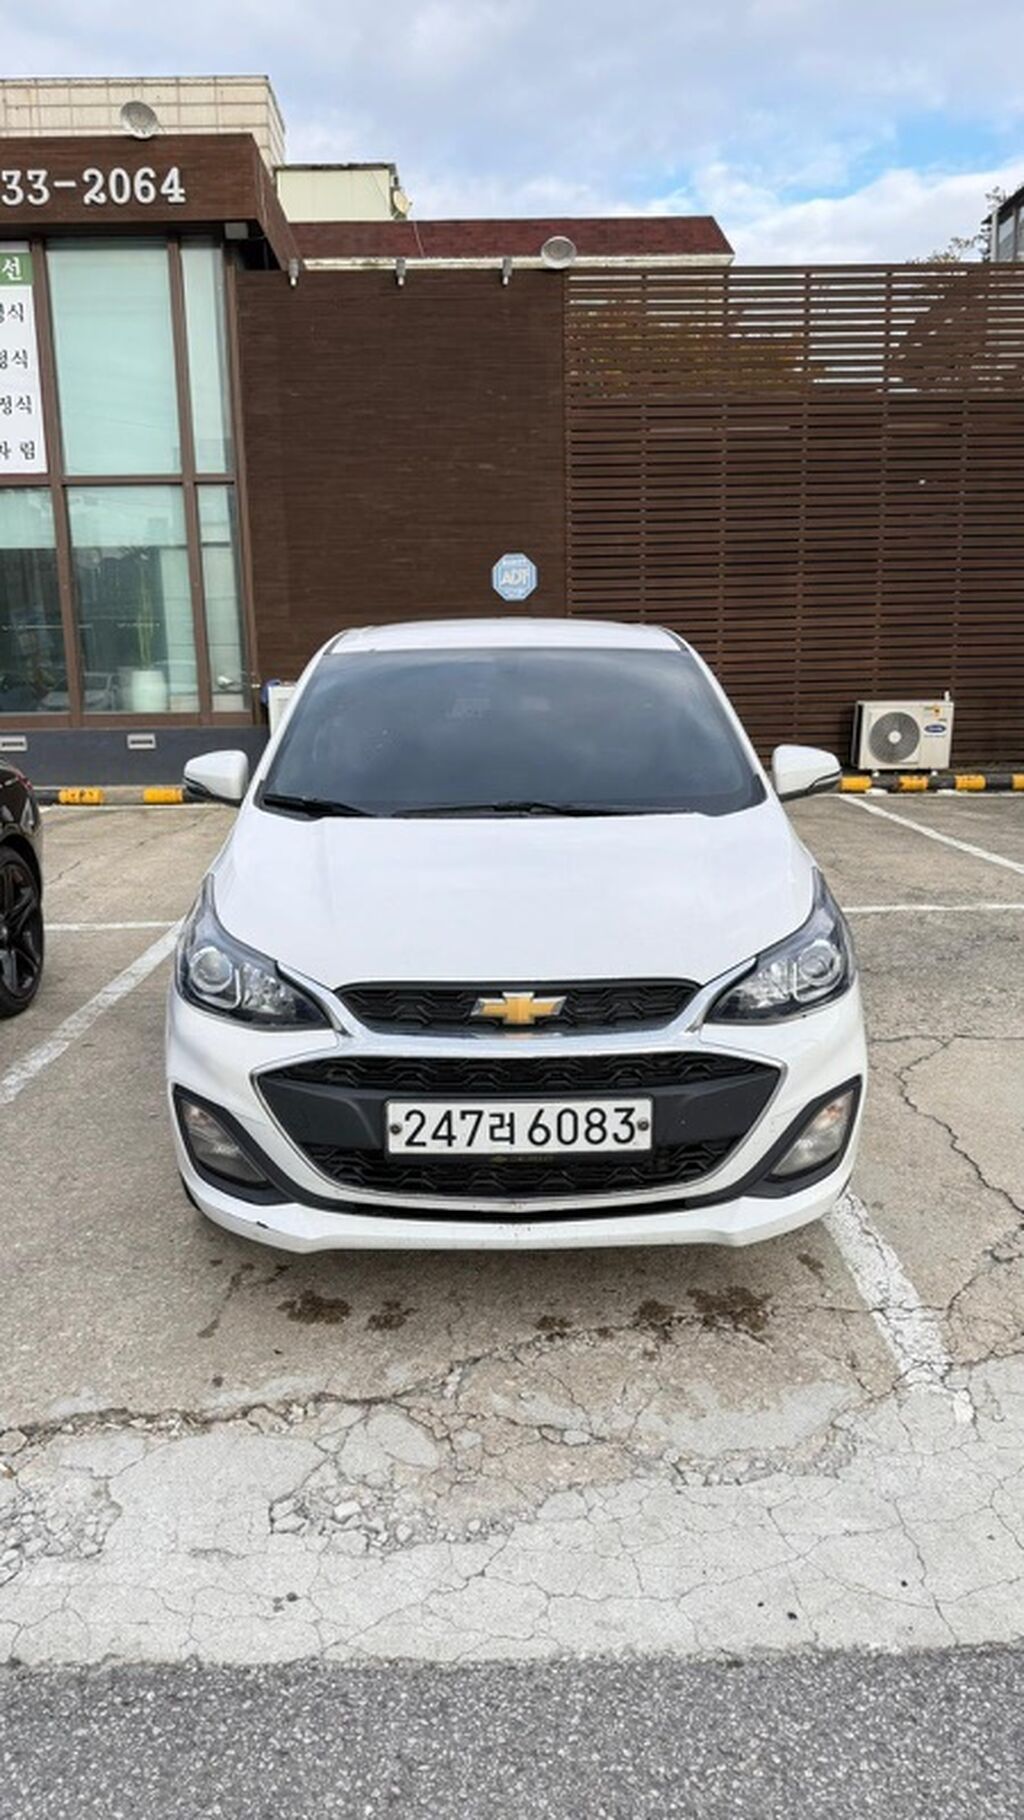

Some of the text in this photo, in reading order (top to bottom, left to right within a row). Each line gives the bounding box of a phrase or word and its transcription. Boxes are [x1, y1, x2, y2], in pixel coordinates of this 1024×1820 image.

[1, 167, 187, 206] 33-2064
[501, 567, 529, 587] ADT
[404, 1107, 636, 1148] 247러 6083
